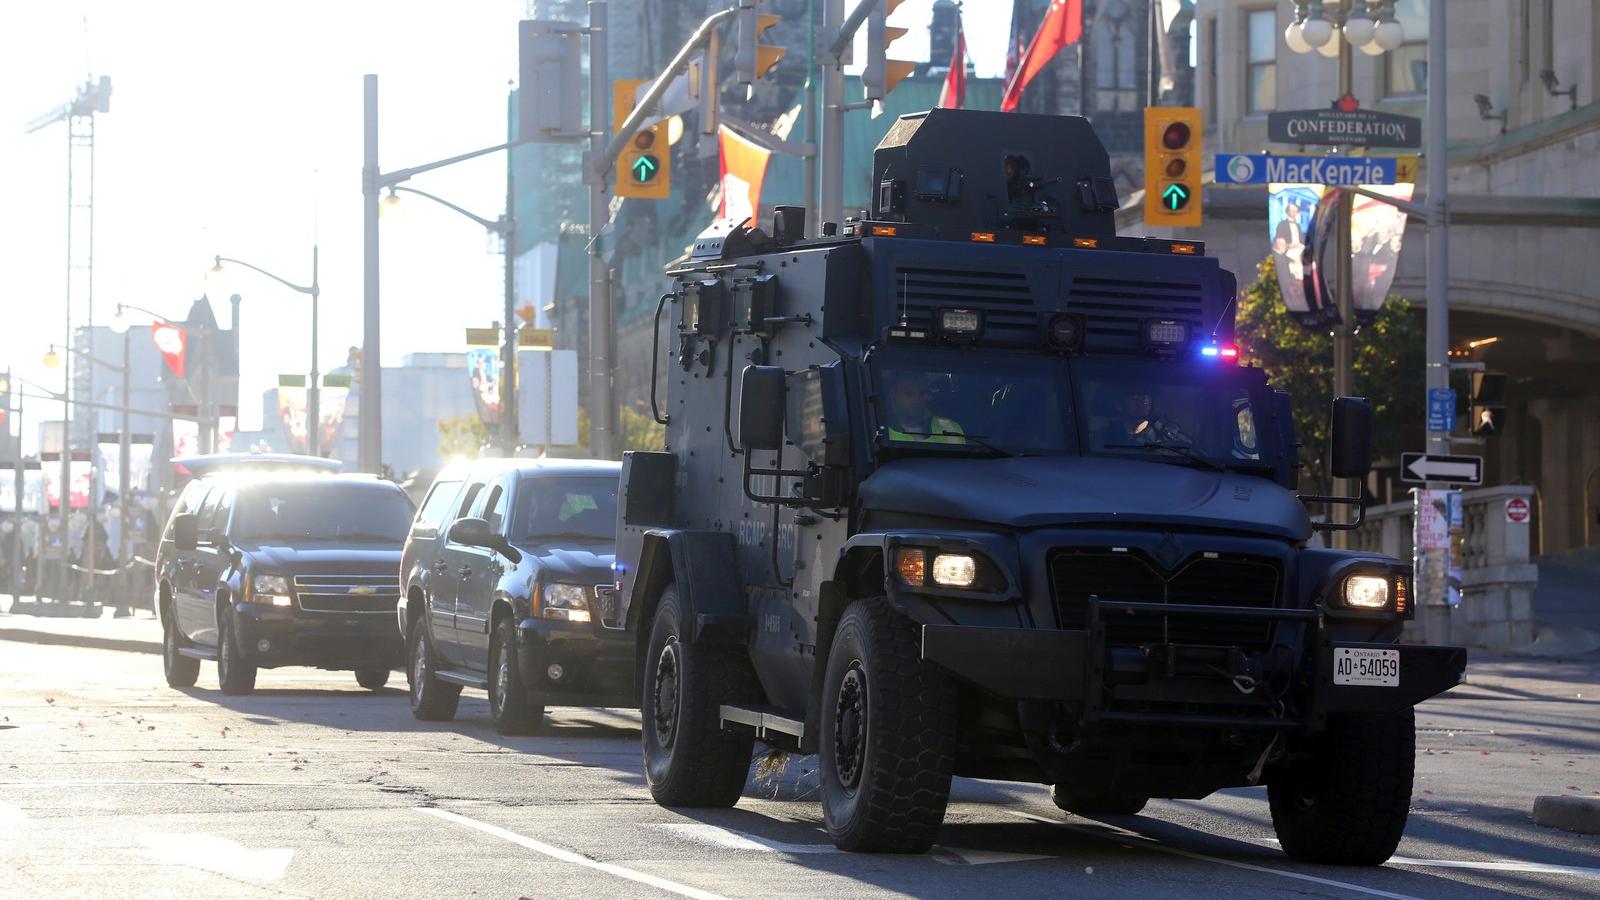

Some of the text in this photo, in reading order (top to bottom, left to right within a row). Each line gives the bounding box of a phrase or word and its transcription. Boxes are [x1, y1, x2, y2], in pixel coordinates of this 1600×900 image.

[1287, 119, 1407, 142] CONFEDERATION
[1266, 157, 1384, 185] MacKenzie
[738, 519, 766, 547] RCMP
